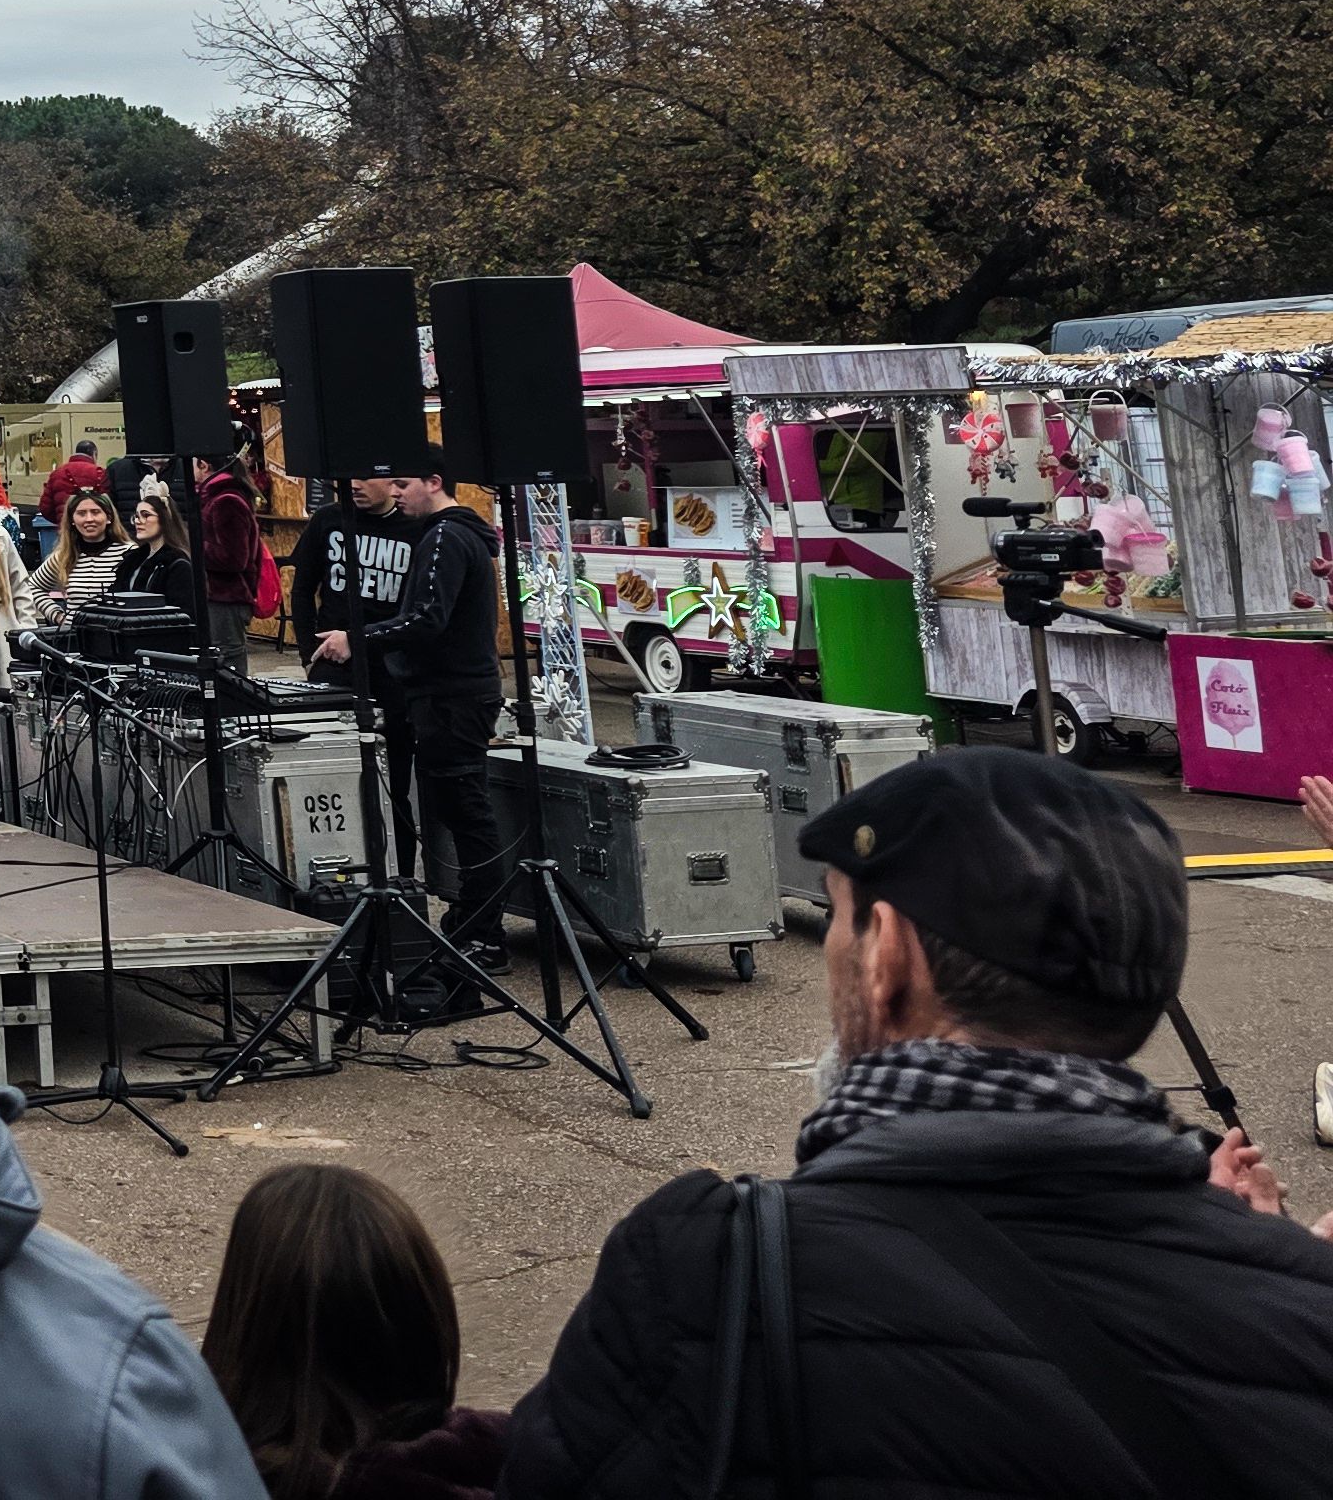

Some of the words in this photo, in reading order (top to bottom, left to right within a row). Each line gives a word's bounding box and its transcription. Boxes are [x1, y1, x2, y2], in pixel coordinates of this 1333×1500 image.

[328, 531, 412, 574] SUND
[330, 563, 403, 603] CEW
[1209, 701, 1251, 717] Fluix
[304, 793, 343, 813] QSC
[309, 813, 346, 834] K12
